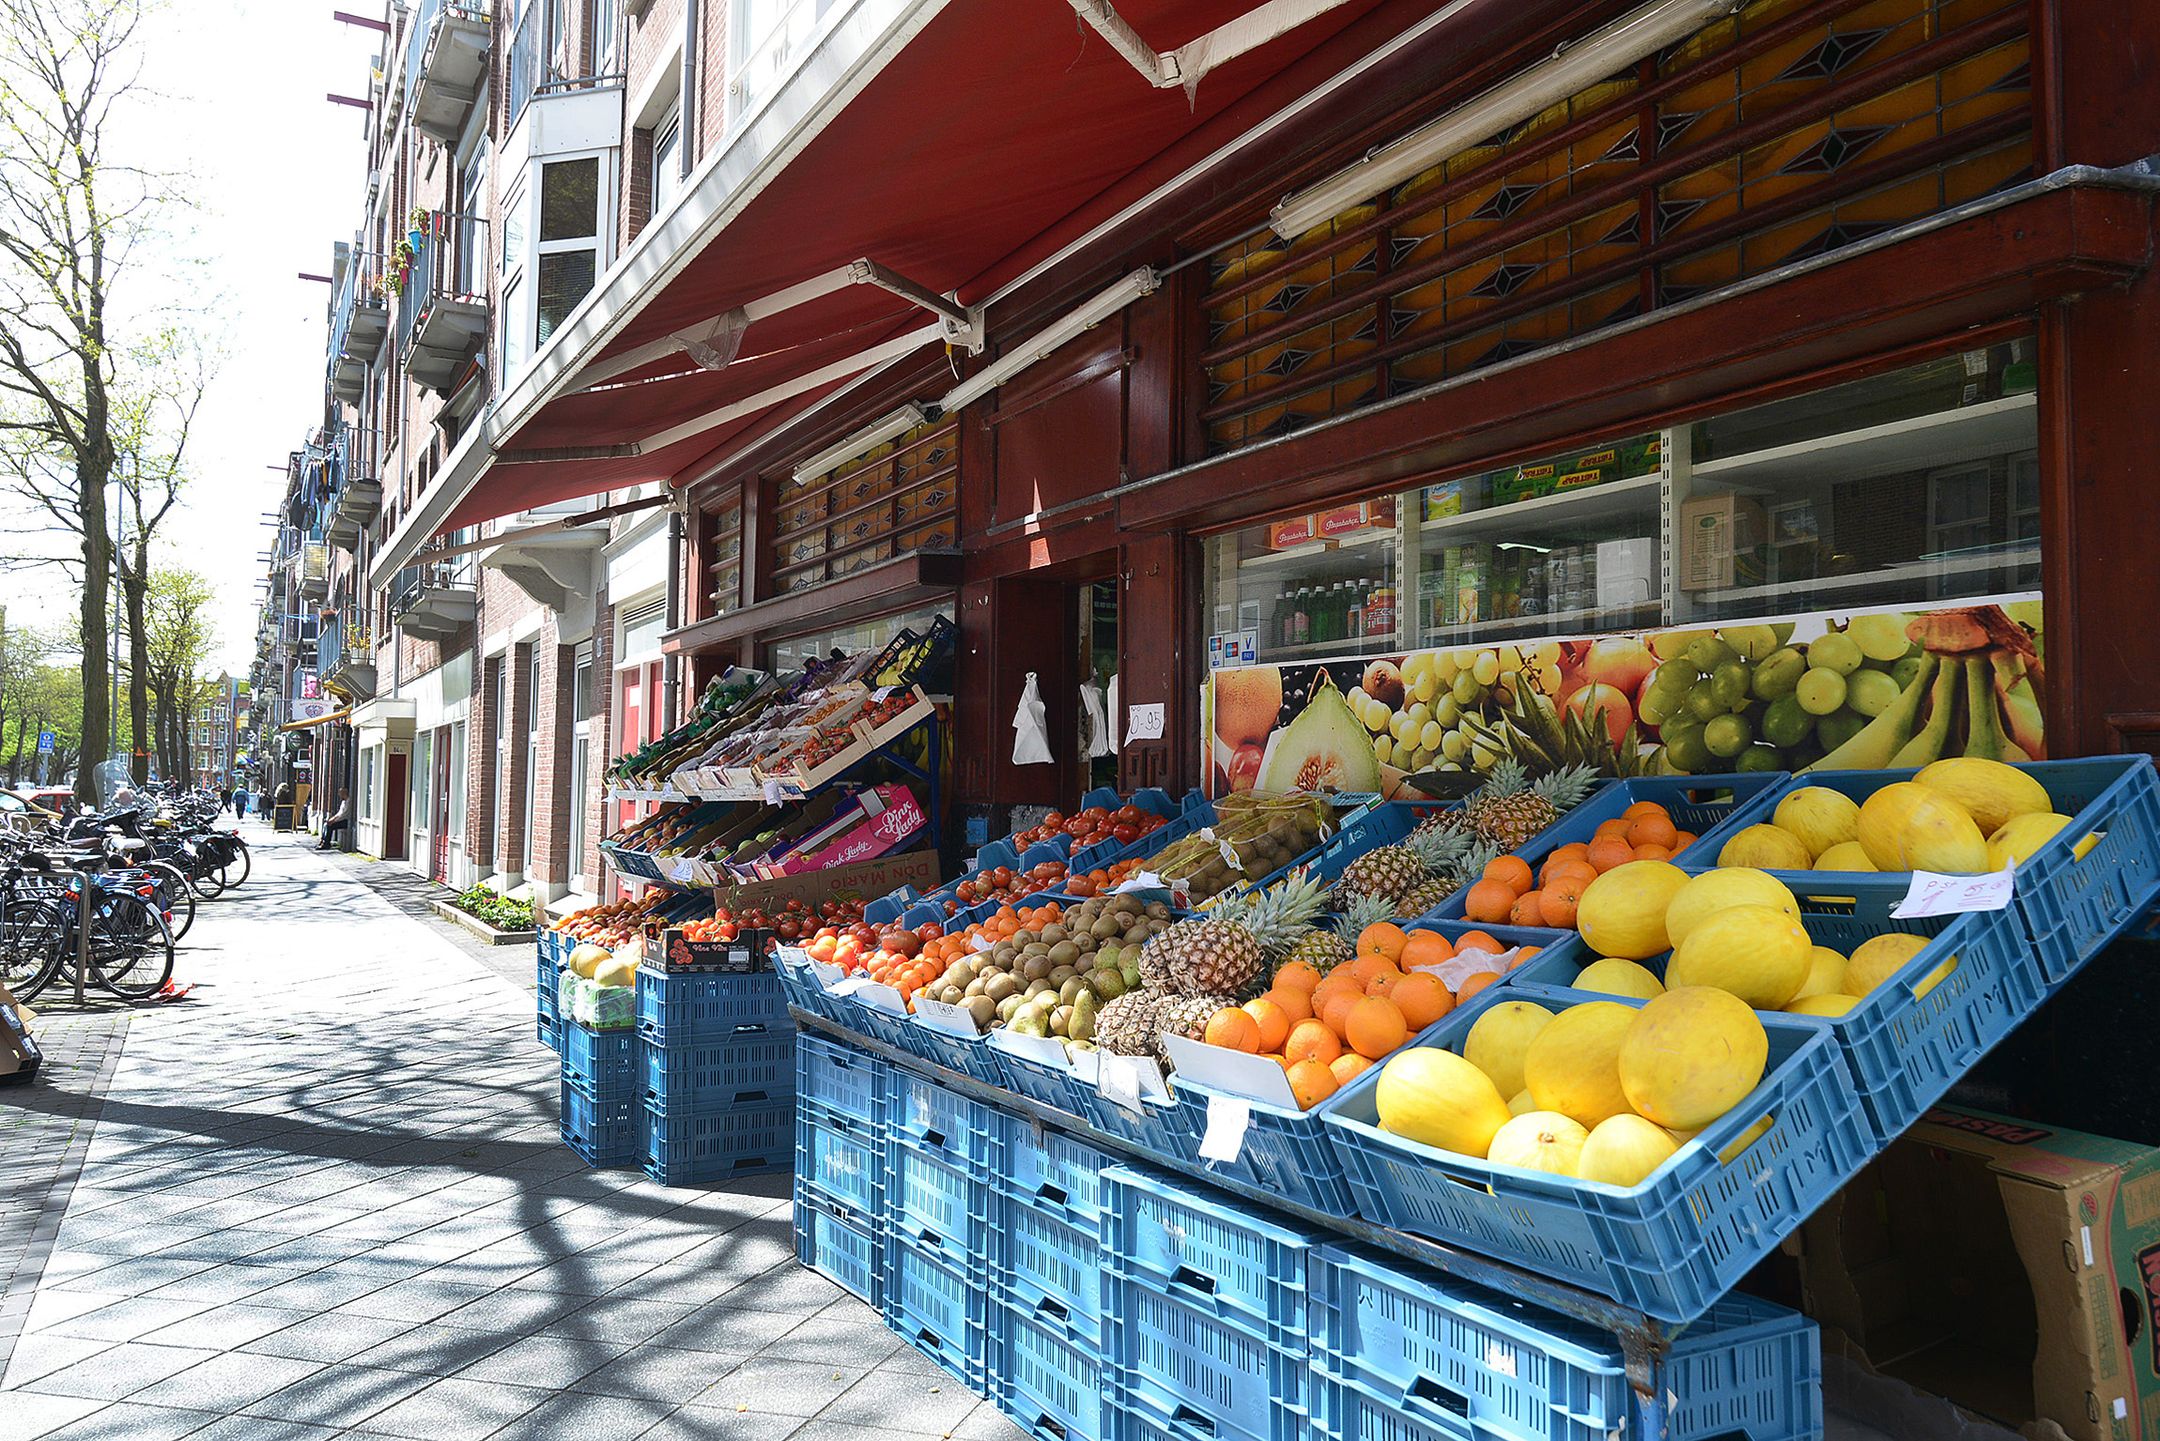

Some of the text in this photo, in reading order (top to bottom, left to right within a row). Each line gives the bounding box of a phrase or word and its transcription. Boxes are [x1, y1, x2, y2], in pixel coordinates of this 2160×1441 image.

[875, 800, 913, 837] Pink
[892, 809, 926, 843] Lady
[822, 840, 872, 870] Pink Lady
[1927, 1108, 2046, 1143] PASIO
